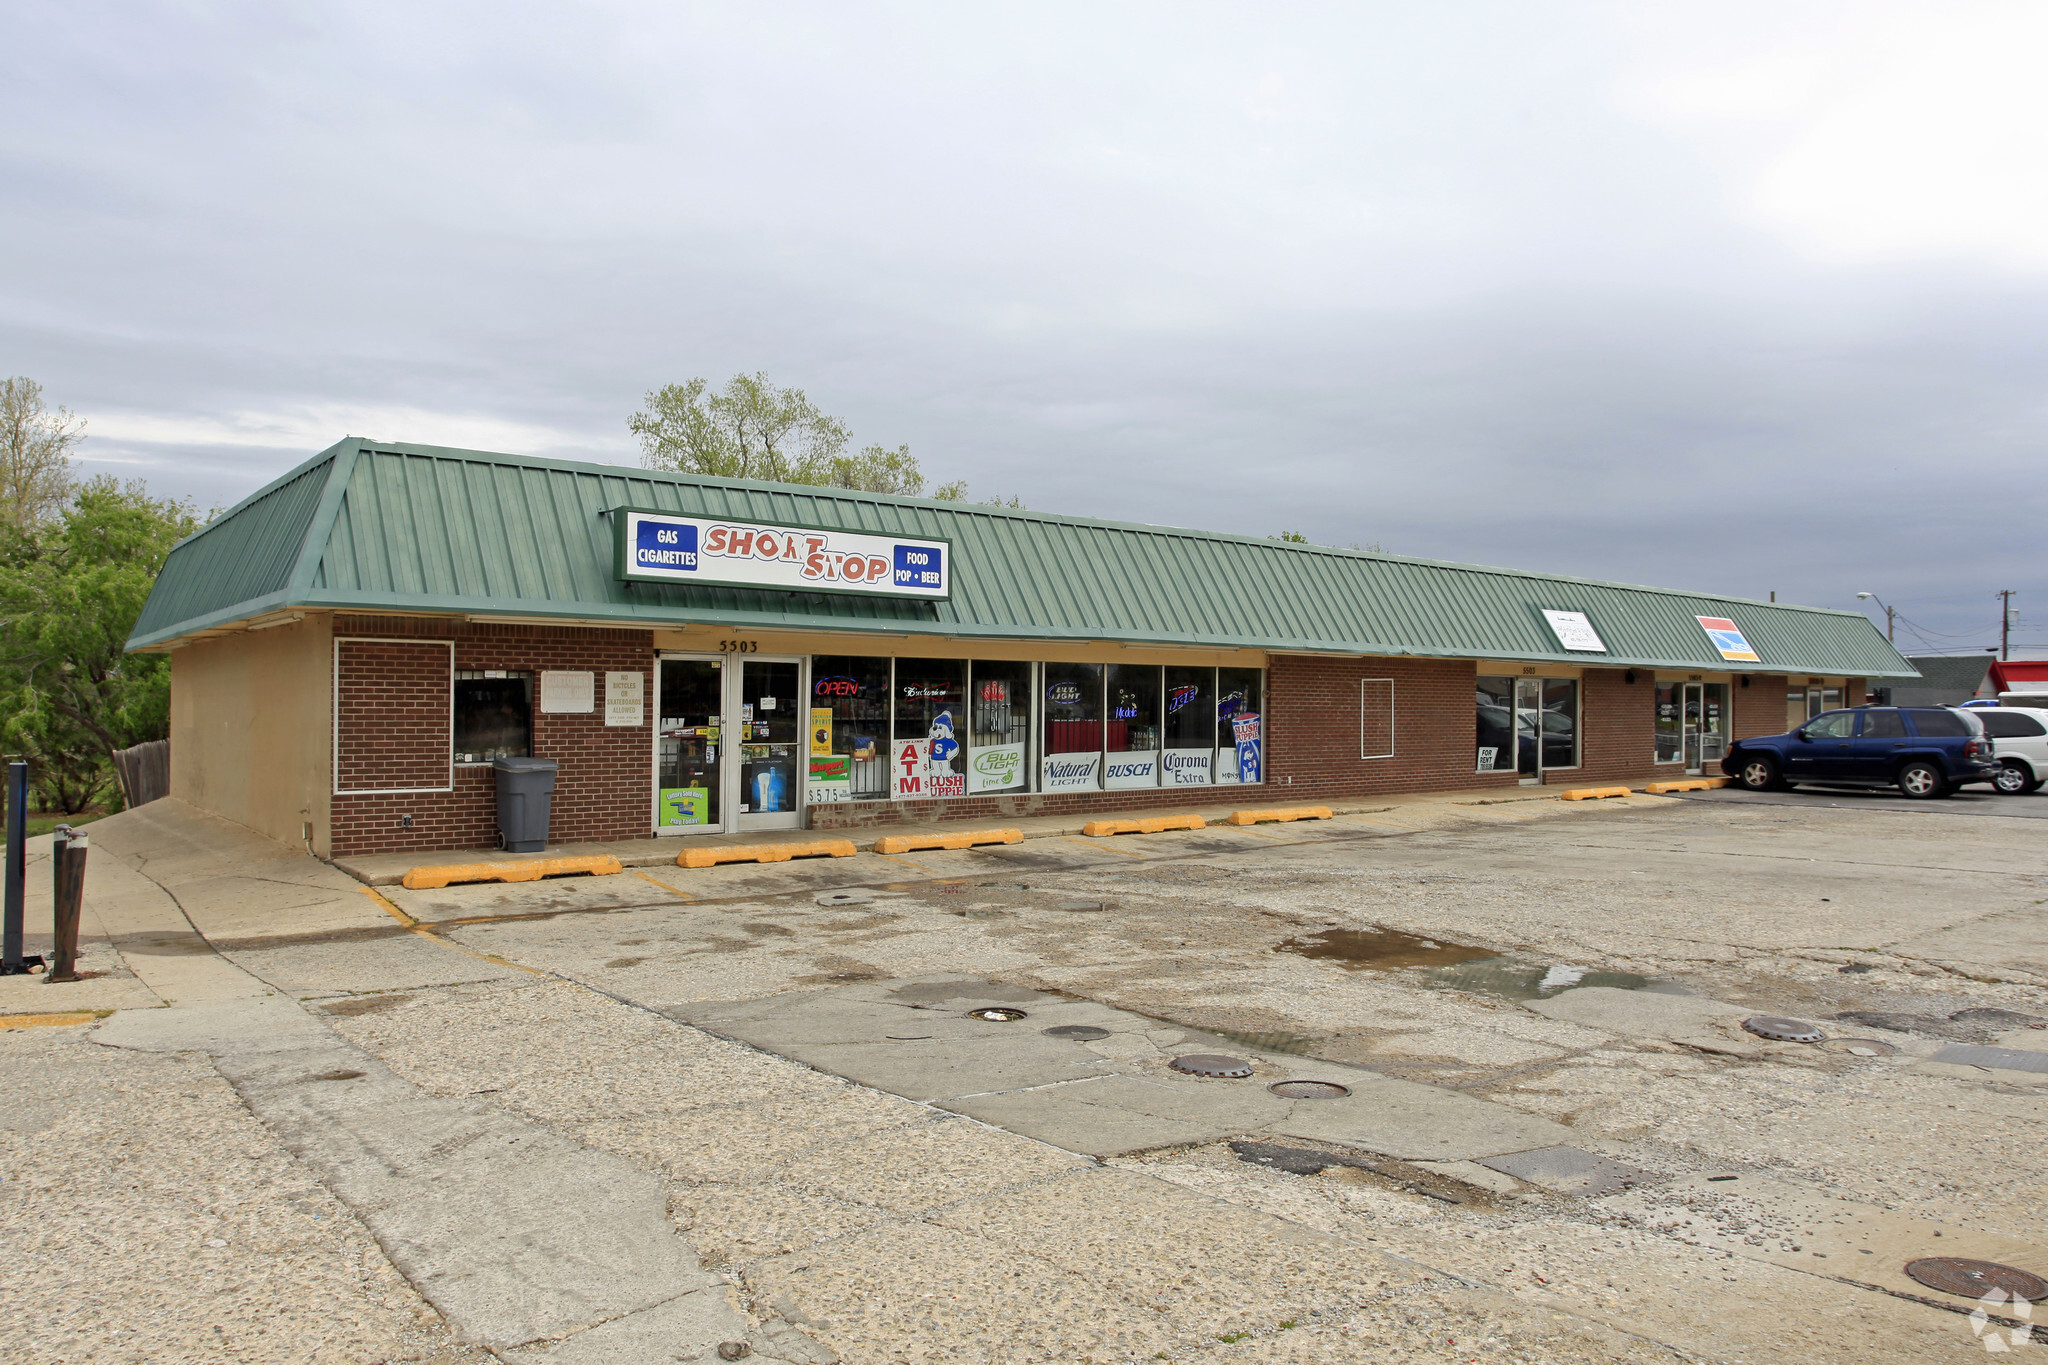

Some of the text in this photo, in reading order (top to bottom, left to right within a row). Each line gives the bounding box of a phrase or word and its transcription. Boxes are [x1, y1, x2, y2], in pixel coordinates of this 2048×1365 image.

[657, 529, 678, 544] GAS
[638, 548, 697, 566] CIGARETTES
[906, 552, 929, 565] FOOD
[896, 569, 940, 584] POP BEER
[719, 640, 758, 653] 5503
[817, 681, 859, 696] OPEN
[1235, 722, 1258, 734] SLUSH
[980, 758, 1021, 771] LIGHT
[987, 752, 1018, 763] BUD
[1163, 752, 1208, 773] Corona
[1480, 756, 1493, 764] RENT
[900, 745, 920, 793] ATM
[1044, 759, 1098, 779] Natural
[1106, 762, 1153, 778] BUSCH
[1174, 769, 1205, 784] Extra
[929, 776, 963, 787] LUSH
[1050, 778, 1089, 787] LIGHT
